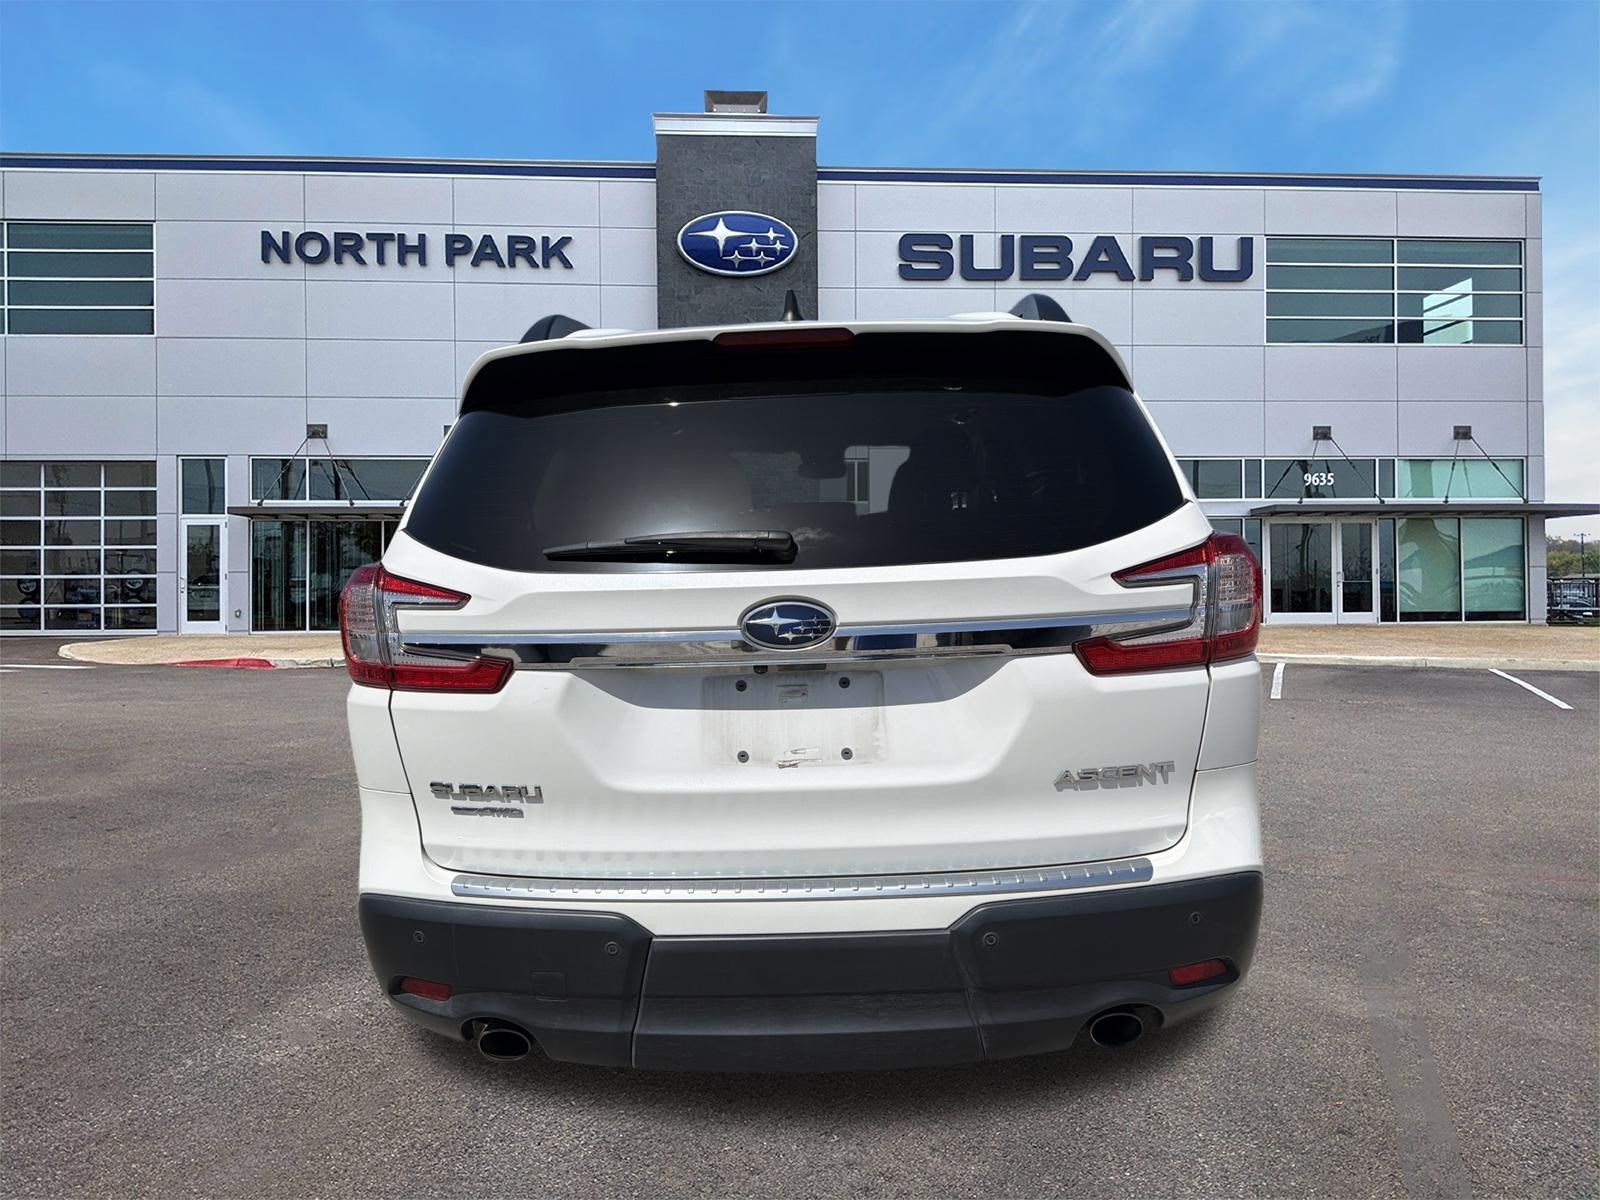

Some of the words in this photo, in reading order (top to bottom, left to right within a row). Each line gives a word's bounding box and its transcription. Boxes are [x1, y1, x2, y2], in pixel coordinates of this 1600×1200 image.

[260, 230, 427, 266] NORTH
[444, 233, 574, 270] PARK
[898, 233, 1254, 283] SUBARU
[1303, 472, 1335, 487] 9635
[429, 781, 544, 804] SUBARU
[1053, 760, 1176, 793] ASCENT
